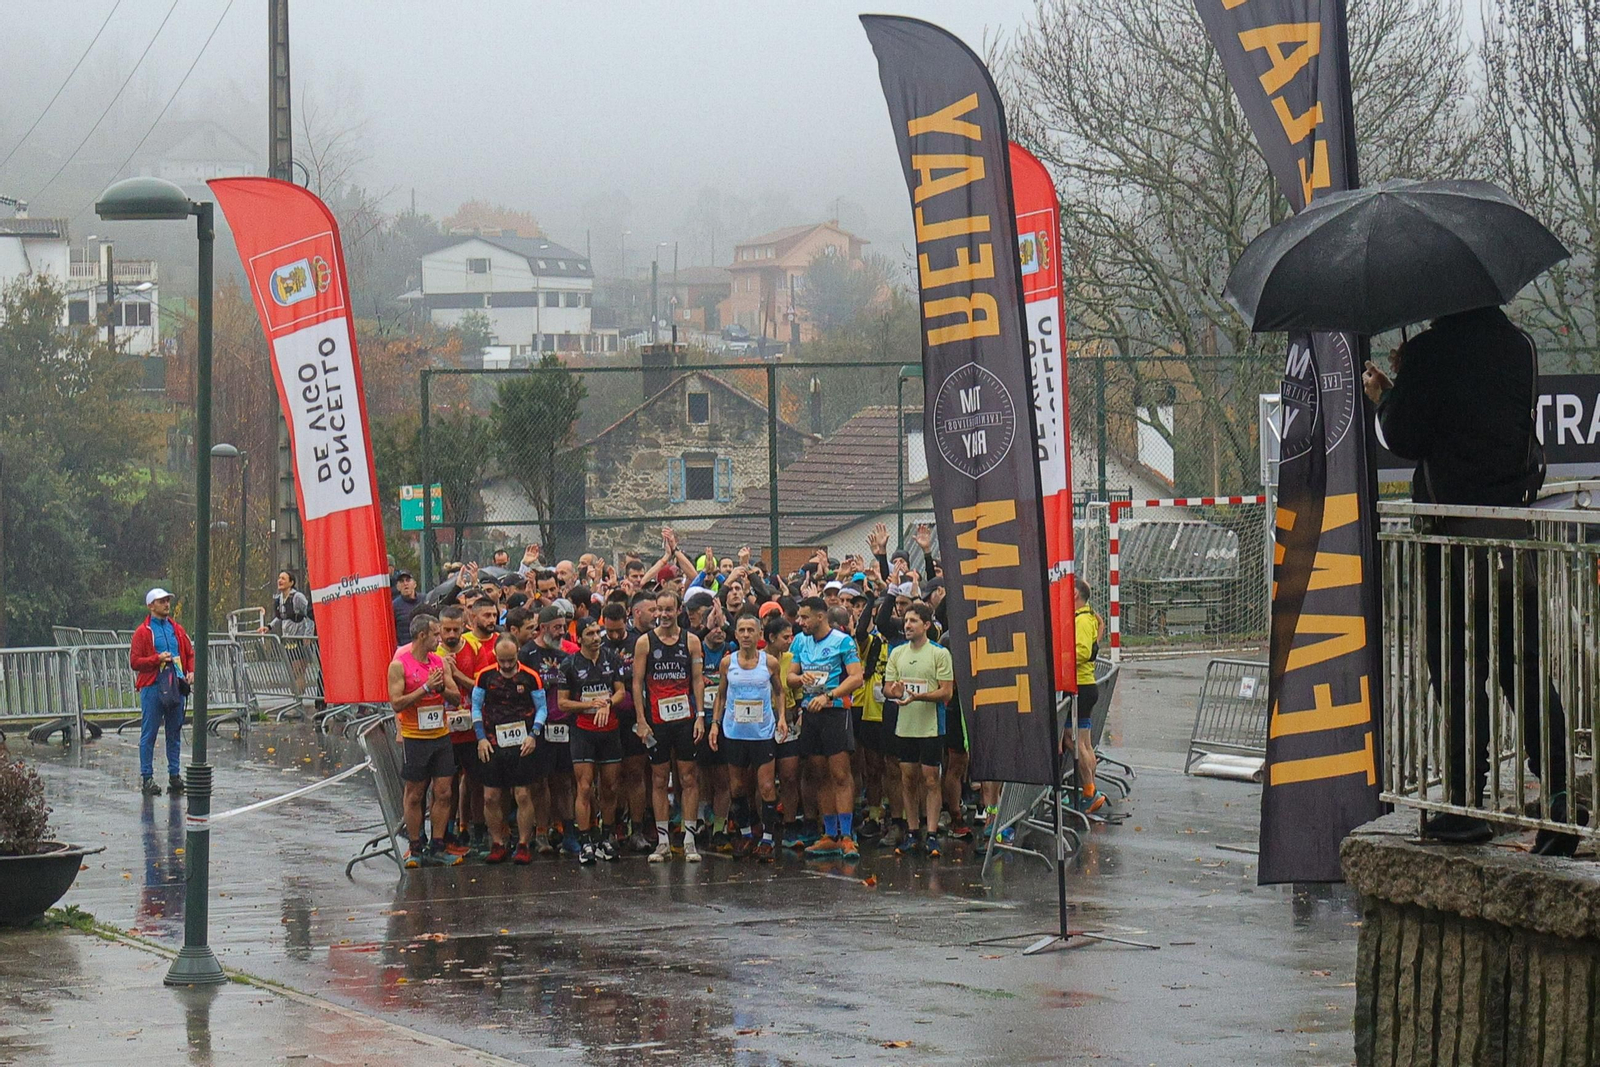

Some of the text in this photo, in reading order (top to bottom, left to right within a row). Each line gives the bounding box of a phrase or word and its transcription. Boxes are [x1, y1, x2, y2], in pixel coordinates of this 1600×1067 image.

[654, 661, 681, 670] GMTA
[581, 683, 608, 693] GMTA
[664, 702, 684, 714] 105
[745, 706, 751, 715] 1
[427, 711, 439, 721] 49
[502, 728, 522, 740] 140
[553, 726, 565, 735] 84
